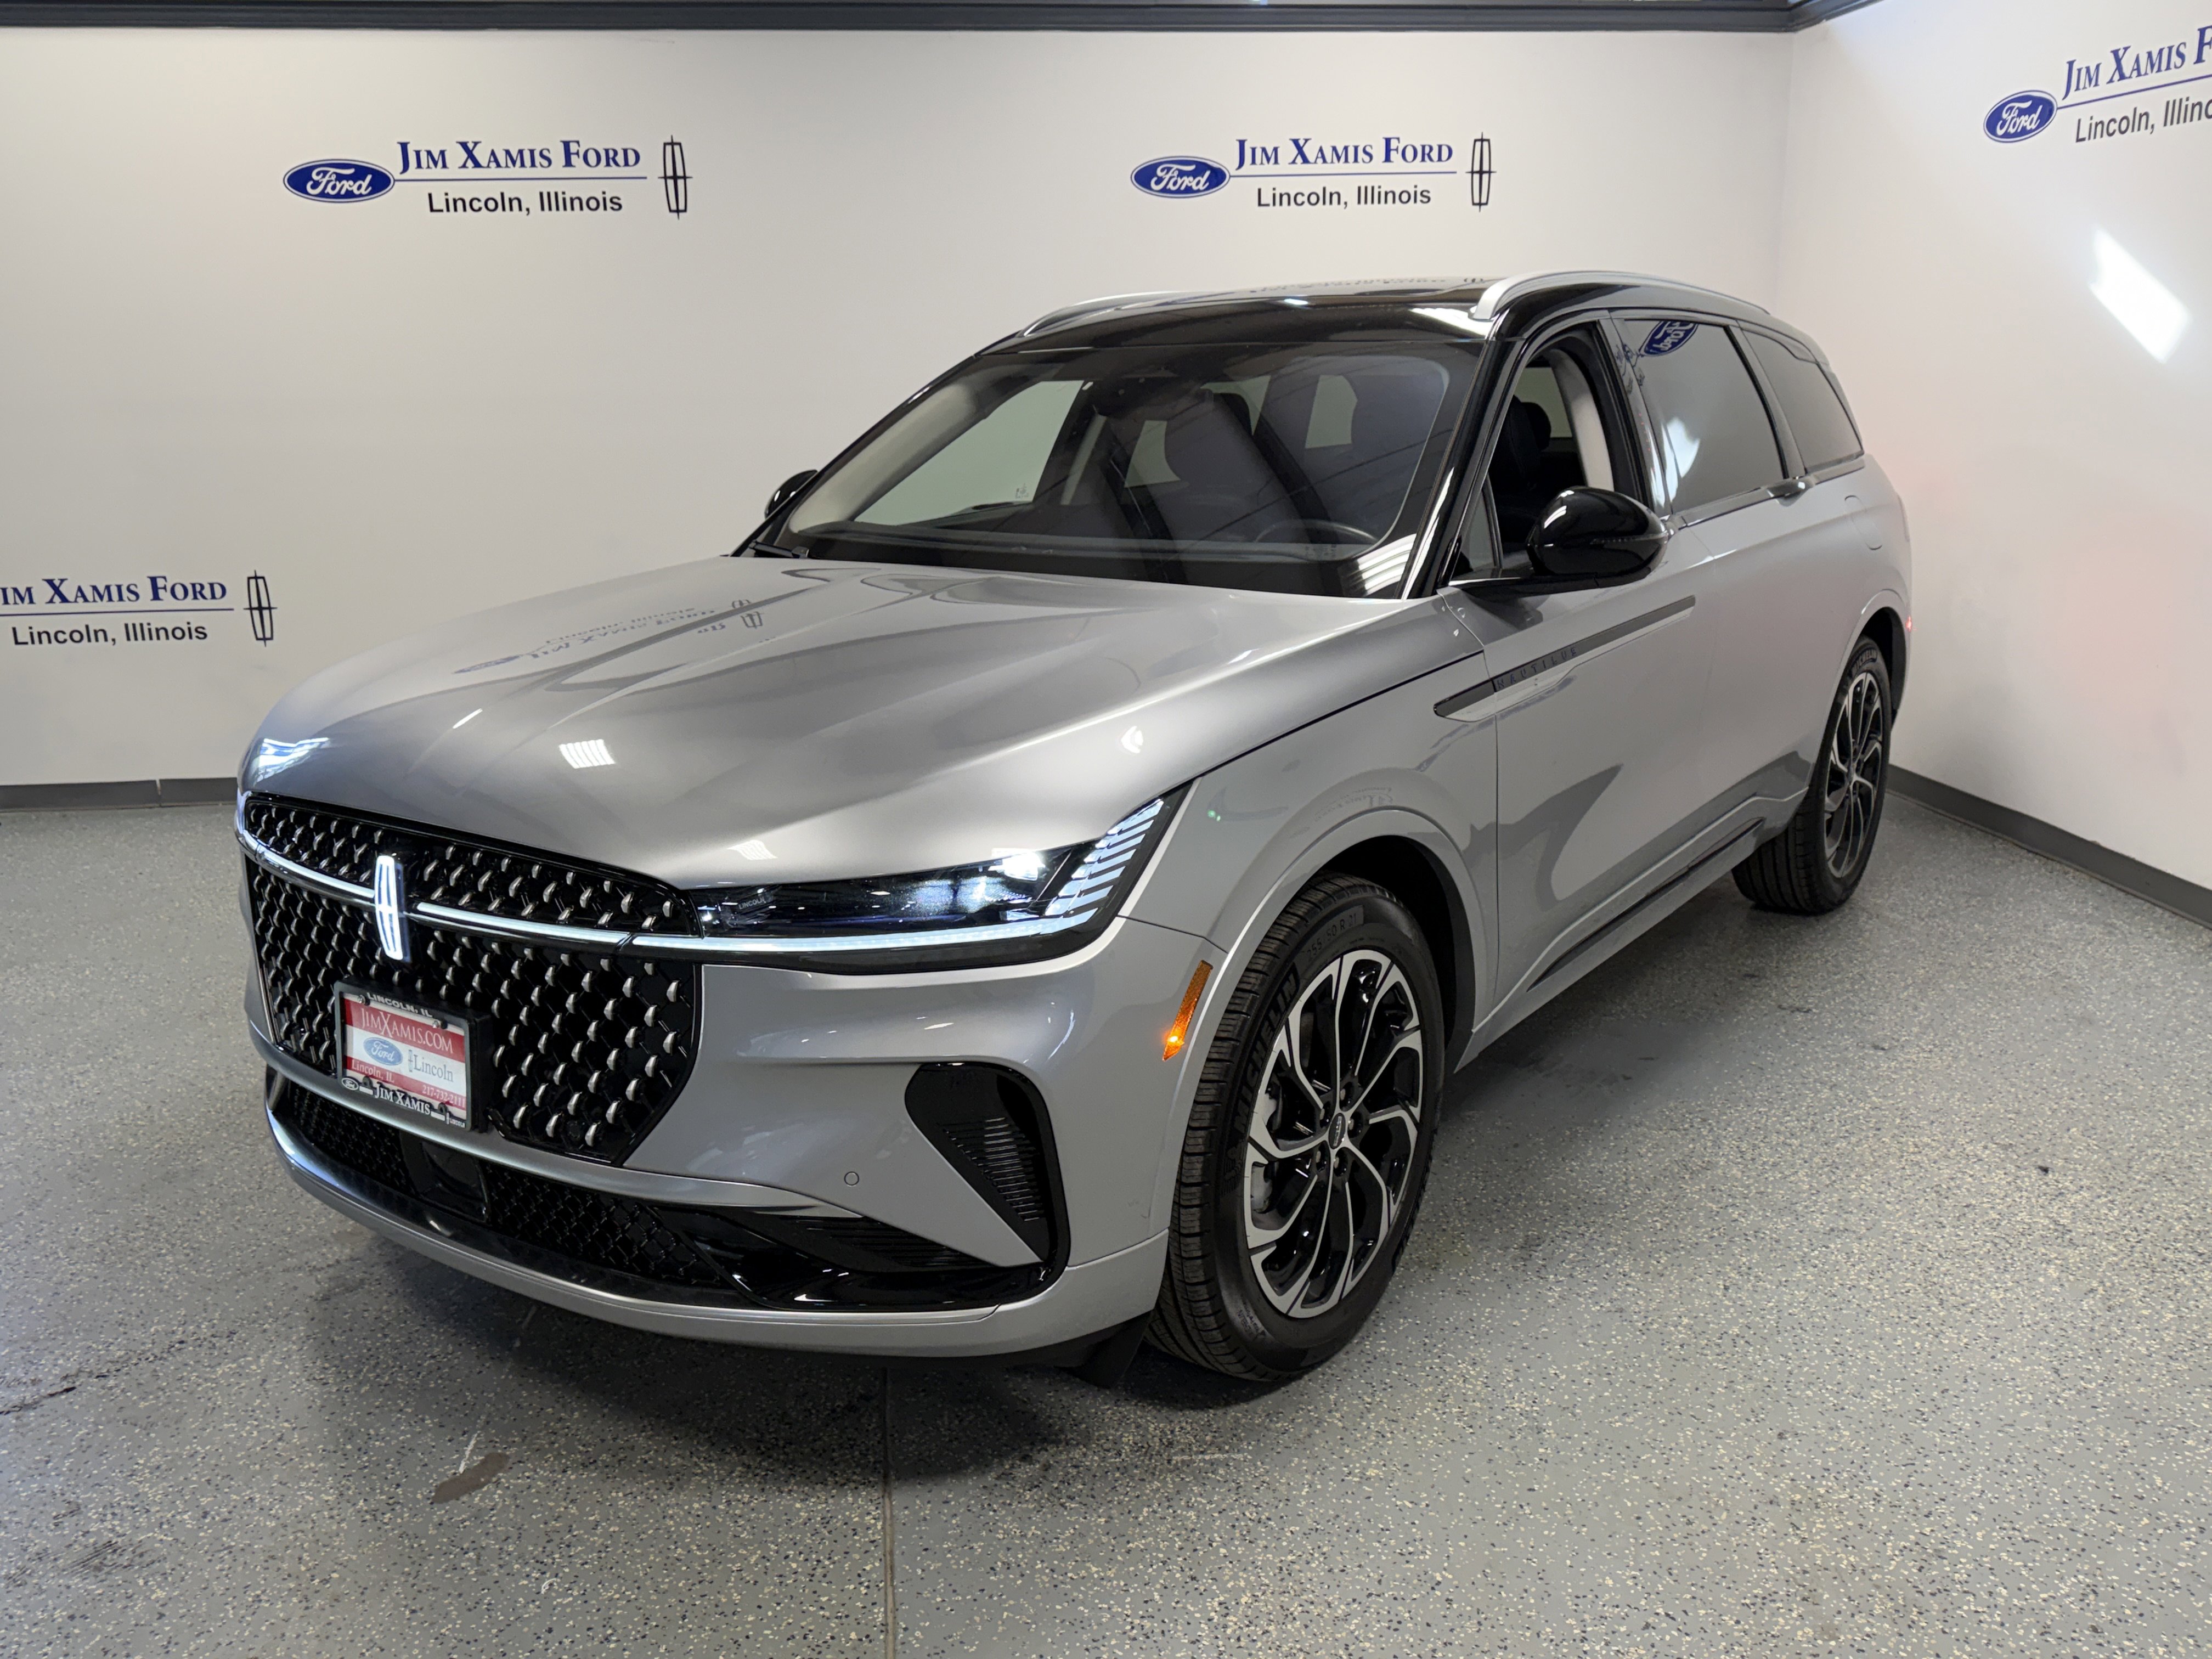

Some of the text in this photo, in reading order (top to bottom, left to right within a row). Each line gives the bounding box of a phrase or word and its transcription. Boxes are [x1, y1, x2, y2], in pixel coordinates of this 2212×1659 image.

[2062, 60, 2102, 101] JIM
[2106, 42, 2186, 84] XAMIS
[1996, 100, 2042, 136] Ford
[2076, 97, 2212, 143] Lincoln, Illino
[397, 139, 641, 175] JIM XAMIS FORD
[1235, 137, 1453, 171] JIM XAMIS FORD
[306, 167, 372, 195] Ford
[1150, 164, 1210, 190] Ford
[428, 191, 623, 216] Lincoln, Illinois
[1257, 185, 1431, 210] Lincoln, Illinois
[0, 576, 227, 605] IM XAMIS FORD
[12, 622, 208, 646] Lincoln, Illinois
[738, 896, 765, 910] LINCOLN
[421, 1008, 433, 1018] IL
[371, 1041, 394, 1062] Ford
[1234, 973, 1298, 1135] MICHELIN
[386, 1071, 395, 1084] IL
[414, 1054, 454, 1082] Lincoln
[375, 1084, 431, 1115] JIM XAMIS
